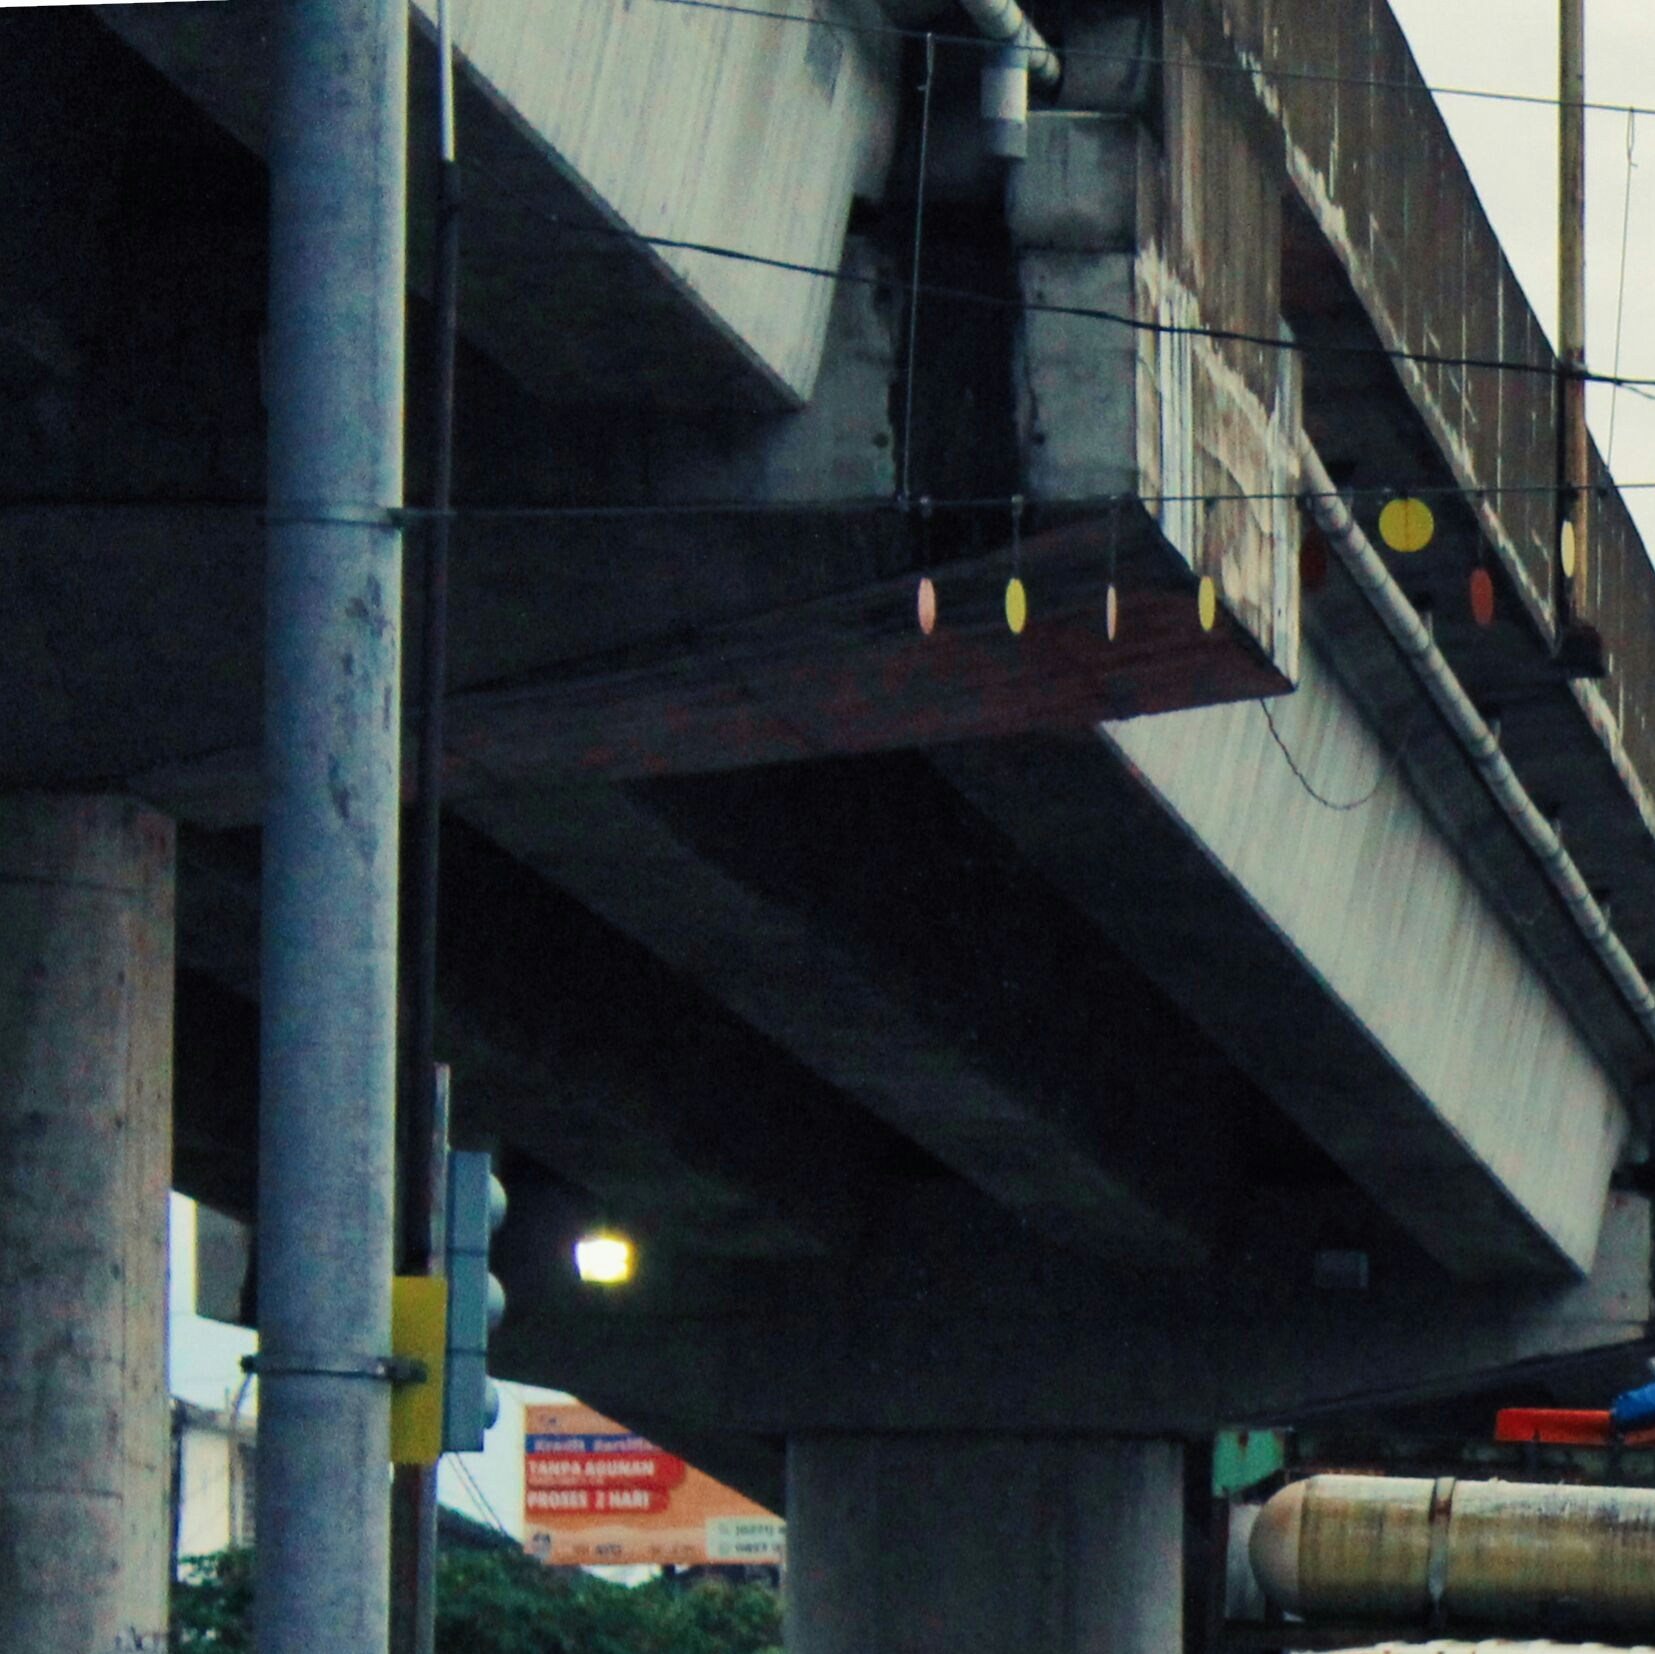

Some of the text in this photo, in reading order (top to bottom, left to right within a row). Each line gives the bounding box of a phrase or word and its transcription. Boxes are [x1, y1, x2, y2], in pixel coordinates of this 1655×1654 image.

[529, 1460, 581, 1476] TANPA
[527, 1490, 587, 1510] PROSES
[609, 1489, 650, 1509] HARI
